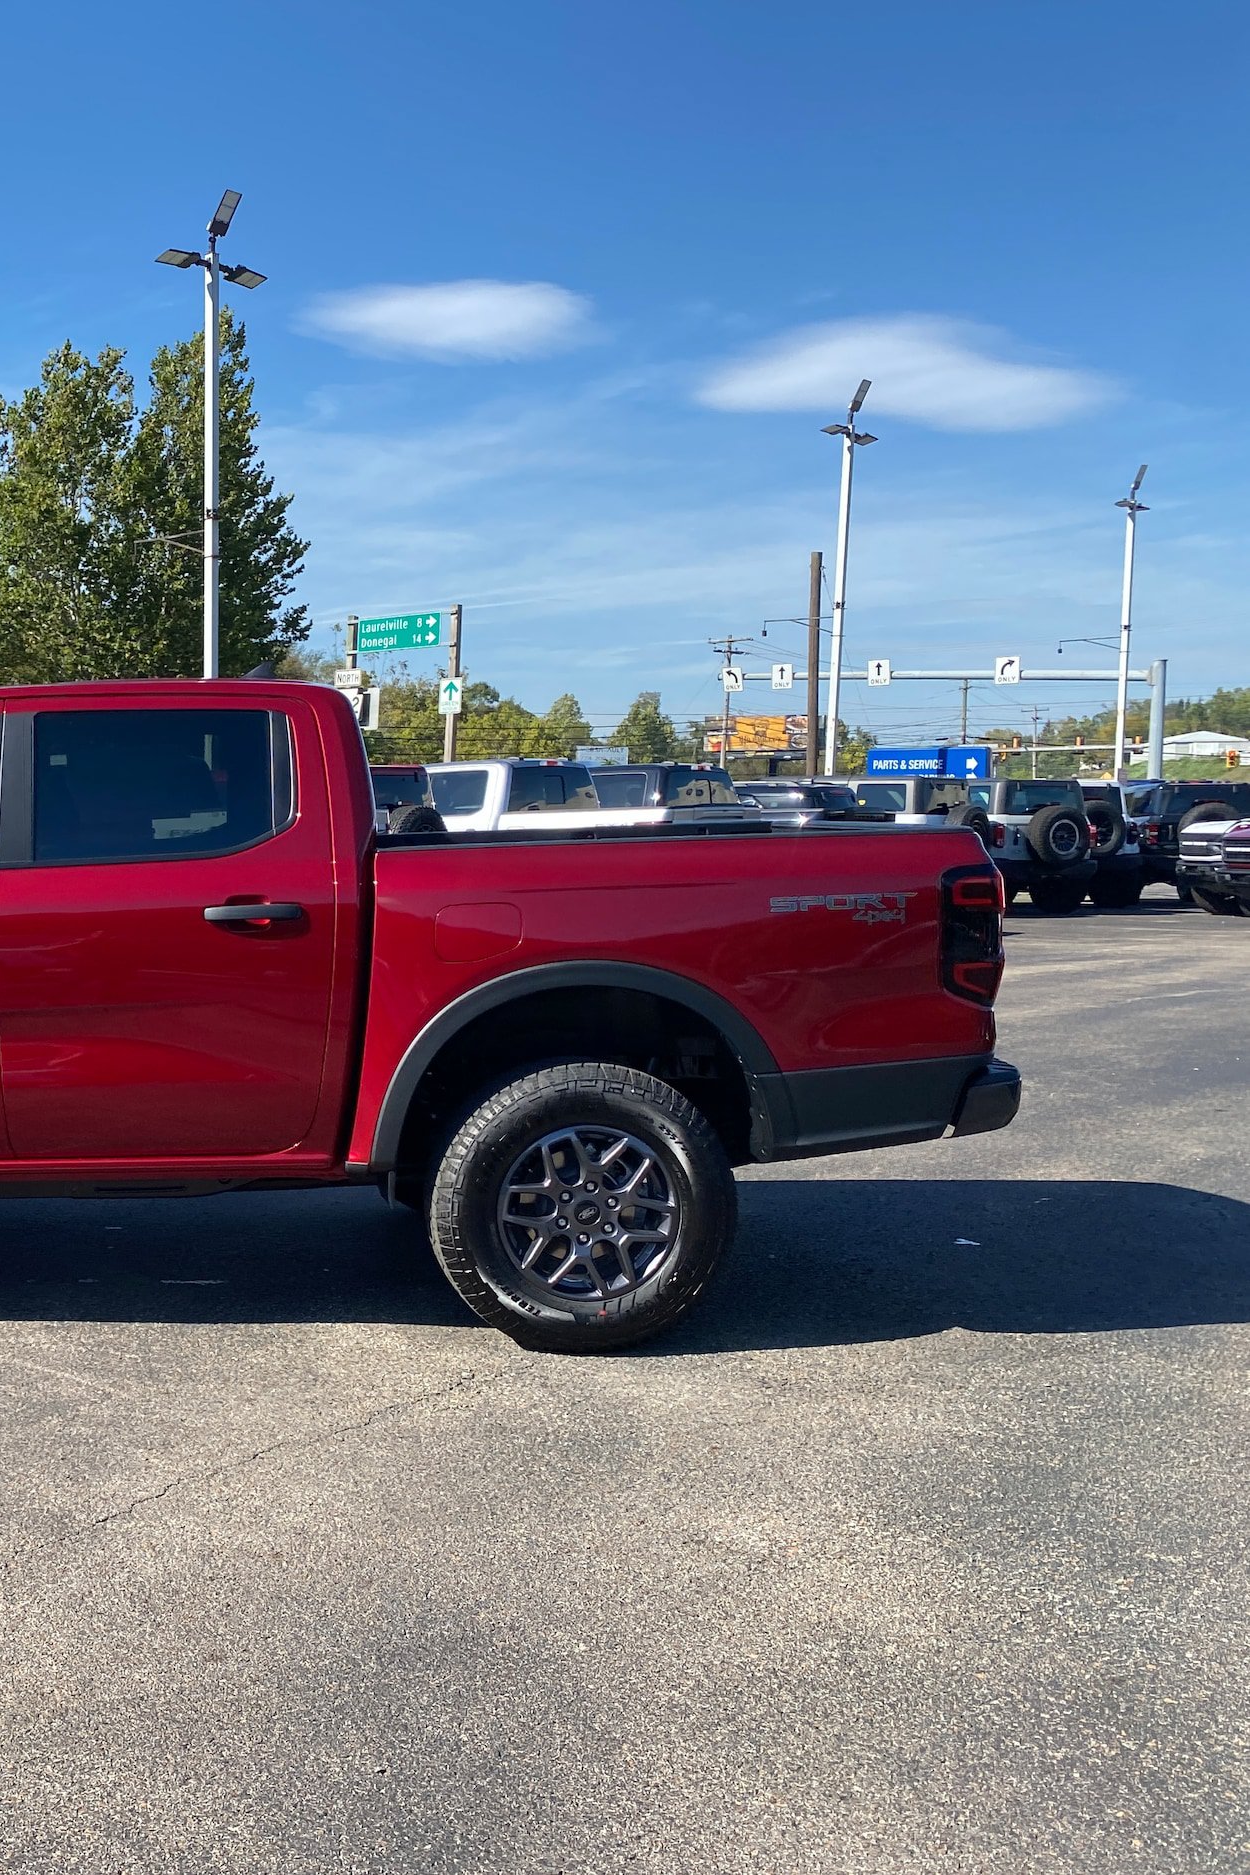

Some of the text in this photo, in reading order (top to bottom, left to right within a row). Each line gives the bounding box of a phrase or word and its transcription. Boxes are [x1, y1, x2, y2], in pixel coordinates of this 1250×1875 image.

[361, 617, 423, 634] Laurelville 8
[361, 633, 422, 649] Donegal 14
[337, 673, 359, 684] NORTH
[873, 759, 944, 770] PARTS & SERVICE
[769, 892, 918, 913] SPORT
